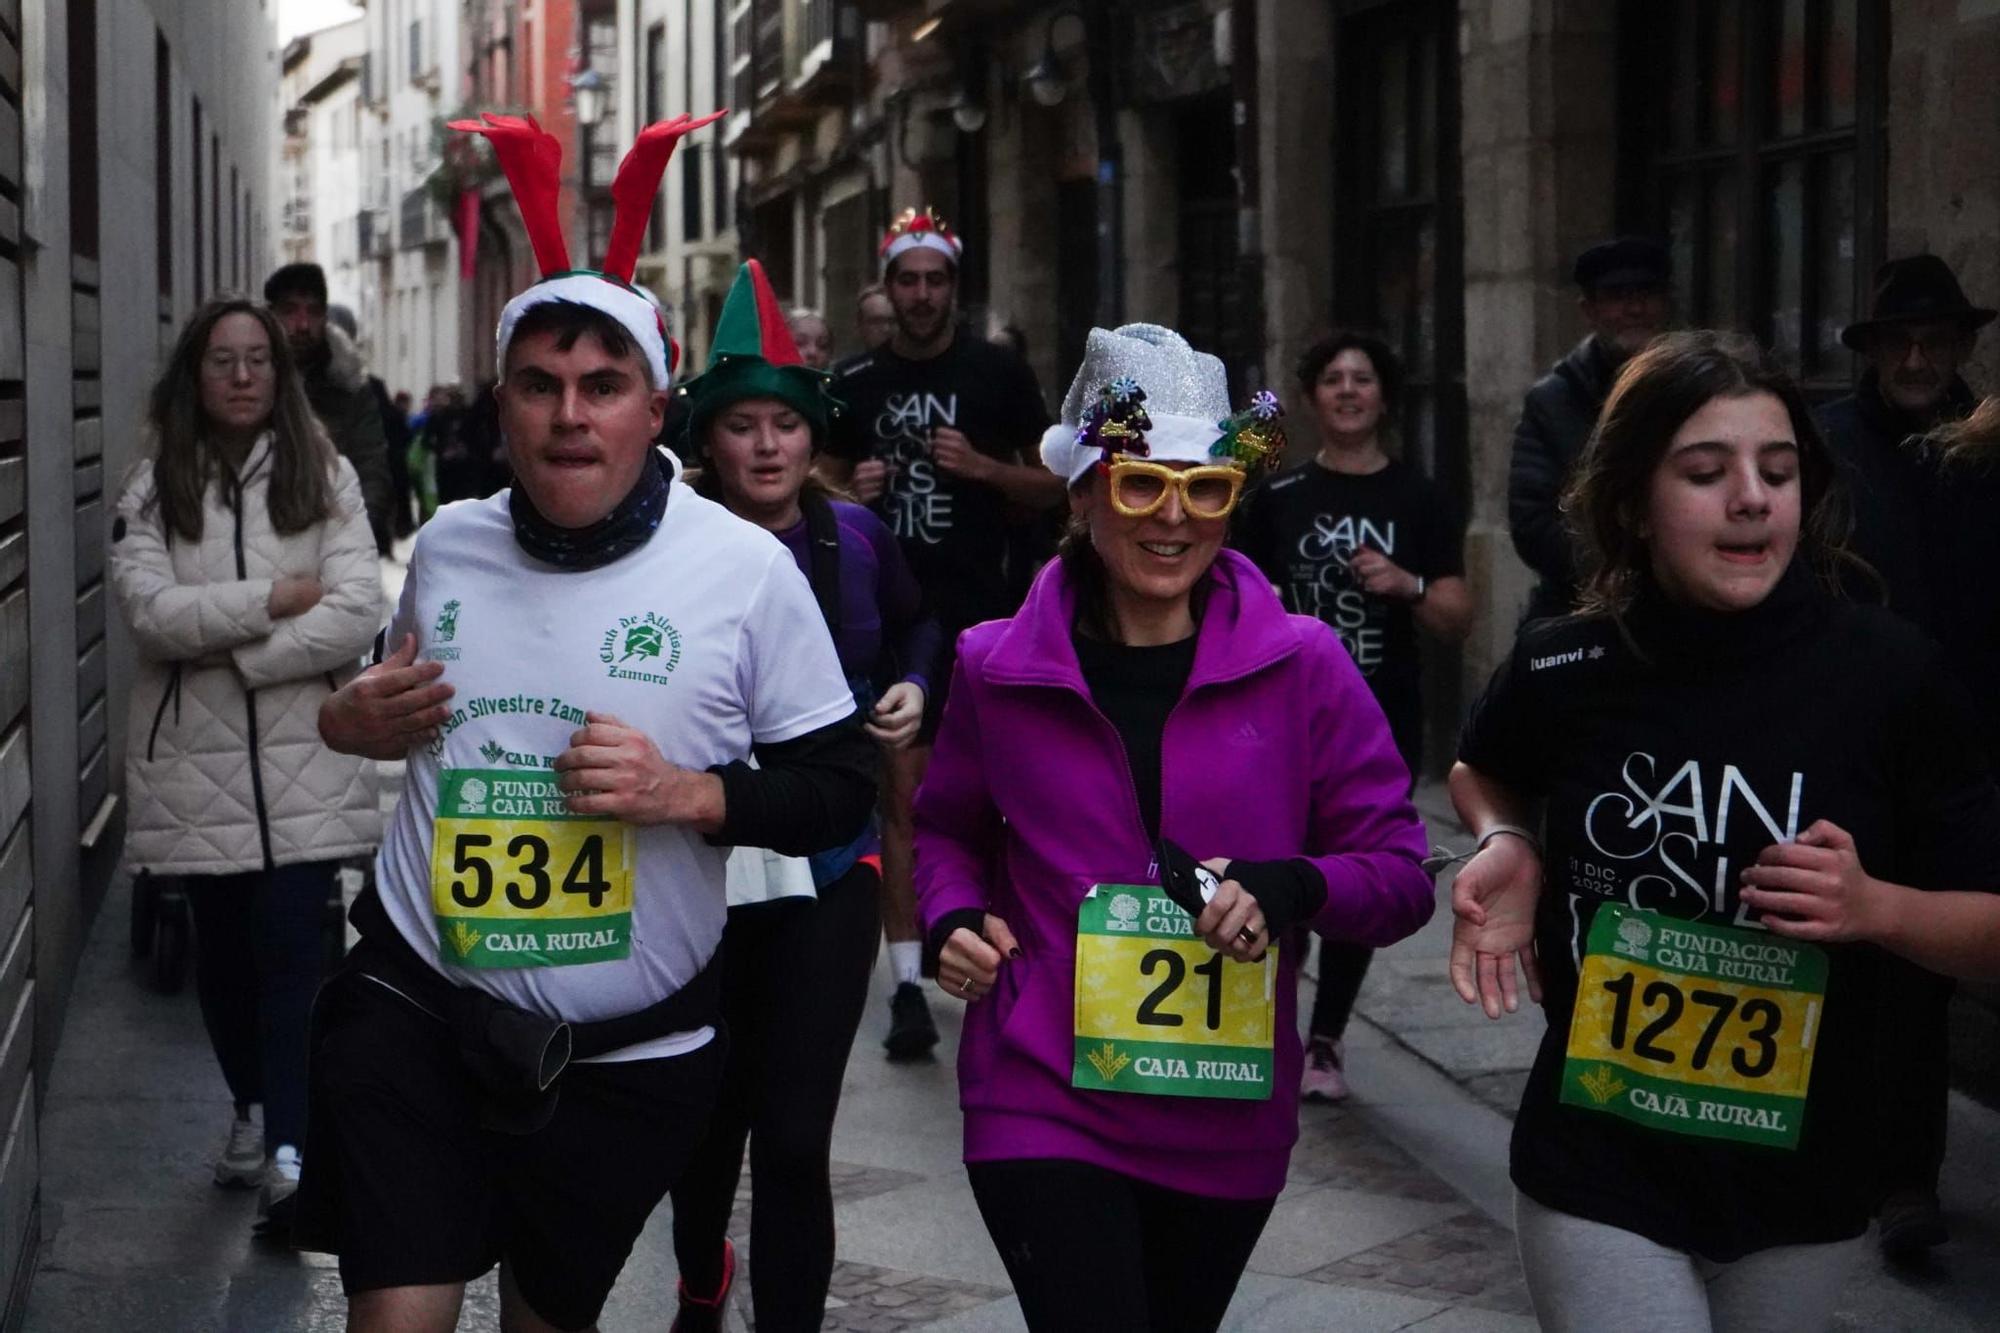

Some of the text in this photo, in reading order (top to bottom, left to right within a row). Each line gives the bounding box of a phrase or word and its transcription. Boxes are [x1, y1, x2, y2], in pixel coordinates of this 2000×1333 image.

[875, 392, 958, 440] SAN
[1299, 512, 1395, 560] SAN
[600, 611, 683, 672] Club de Atletismo
[608, 664, 668, 686] Zamora
[468, 694, 546, 719] Silvestre
[505, 752, 538, 767] CAJA
[491, 799, 535, 816] CAJA
[1585, 751, 1804, 860] SAN
[451, 833, 612, 910] 534
[1571, 875, 1616, 896] 2022
[485, 929, 620, 952] CAJA RURAL
[1146, 917, 1194, 936] CAJA
[1655, 948, 1794, 986] CAJA RURAL
[1658, 928, 1800, 968] FUNDACION
[1136, 948, 1223, 1031] 21
[1603, 971, 1782, 1078] 1273
[1134, 1056, 1264, 1083] CAJA RURAL
[1628, 1087, 1788, 1132] CAJA RURAL
